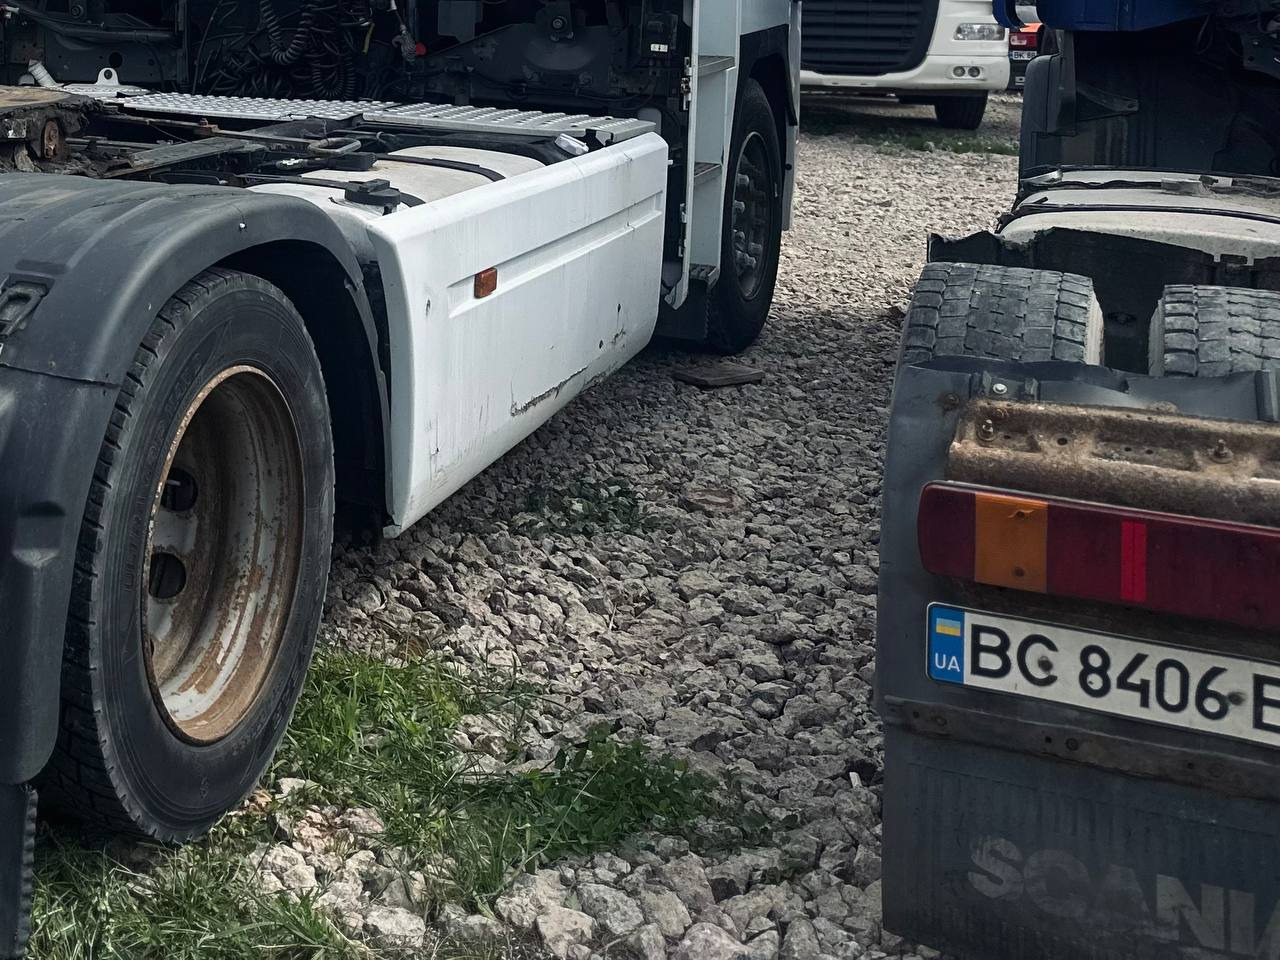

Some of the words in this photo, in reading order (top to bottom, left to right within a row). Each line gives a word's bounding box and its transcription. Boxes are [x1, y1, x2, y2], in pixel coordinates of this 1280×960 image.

[934, 652, 961, 673] UA
[970, 623, 1059, 687] BC
[1080, 644, 1229, 721] 8406
[967, 835, 1280, 960] SCANI
